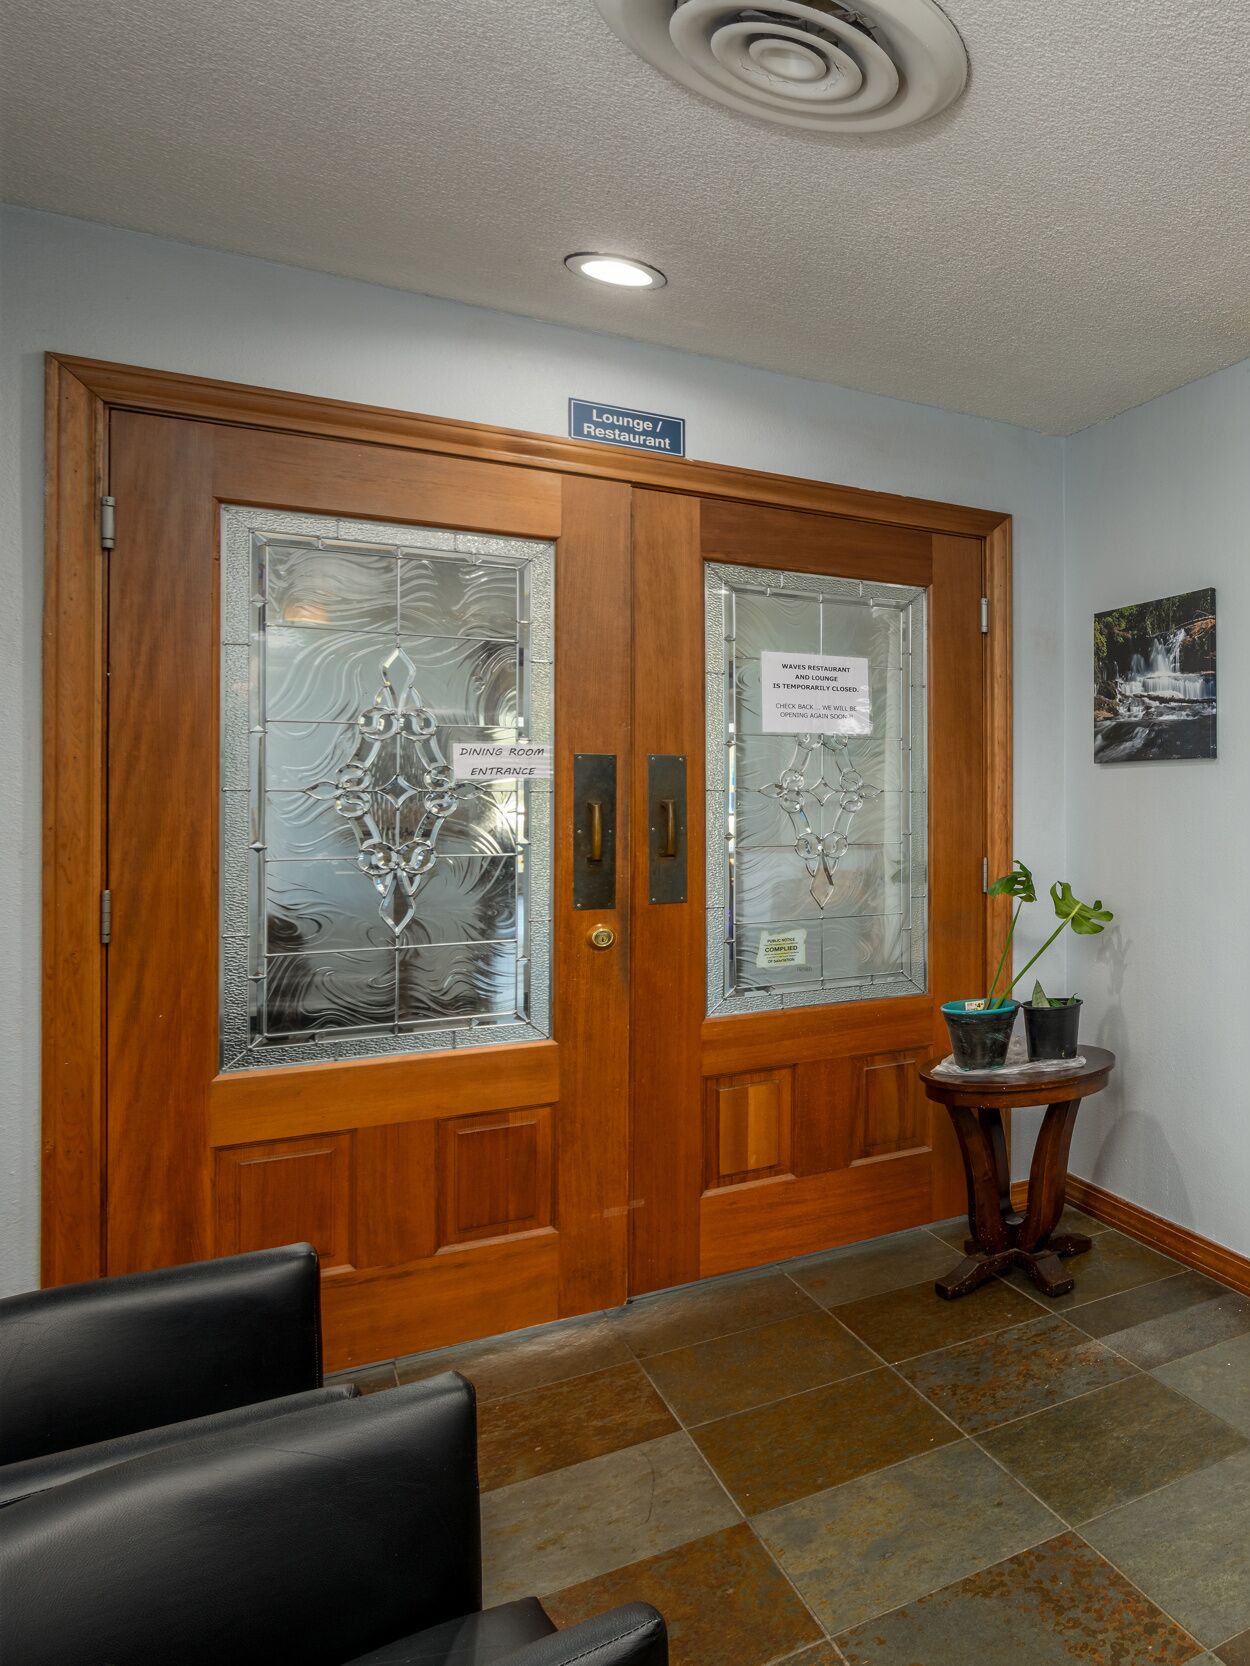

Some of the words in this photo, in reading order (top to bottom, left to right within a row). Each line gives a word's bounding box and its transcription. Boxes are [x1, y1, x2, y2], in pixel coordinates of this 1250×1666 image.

[592, 408, 653, 431] Lounge
[656, 421, 663, 432] /
[583, 422, 671, 449] Restaurant
[807, 665, 850, 673] RESTAURANT
[782, 683, 830, 691] TEMPORARILY
[459, 747, 503, 756] DINING
[508, 748, 545, 757] ROOM
[470, 766, 537, 776] ENTRANCE
